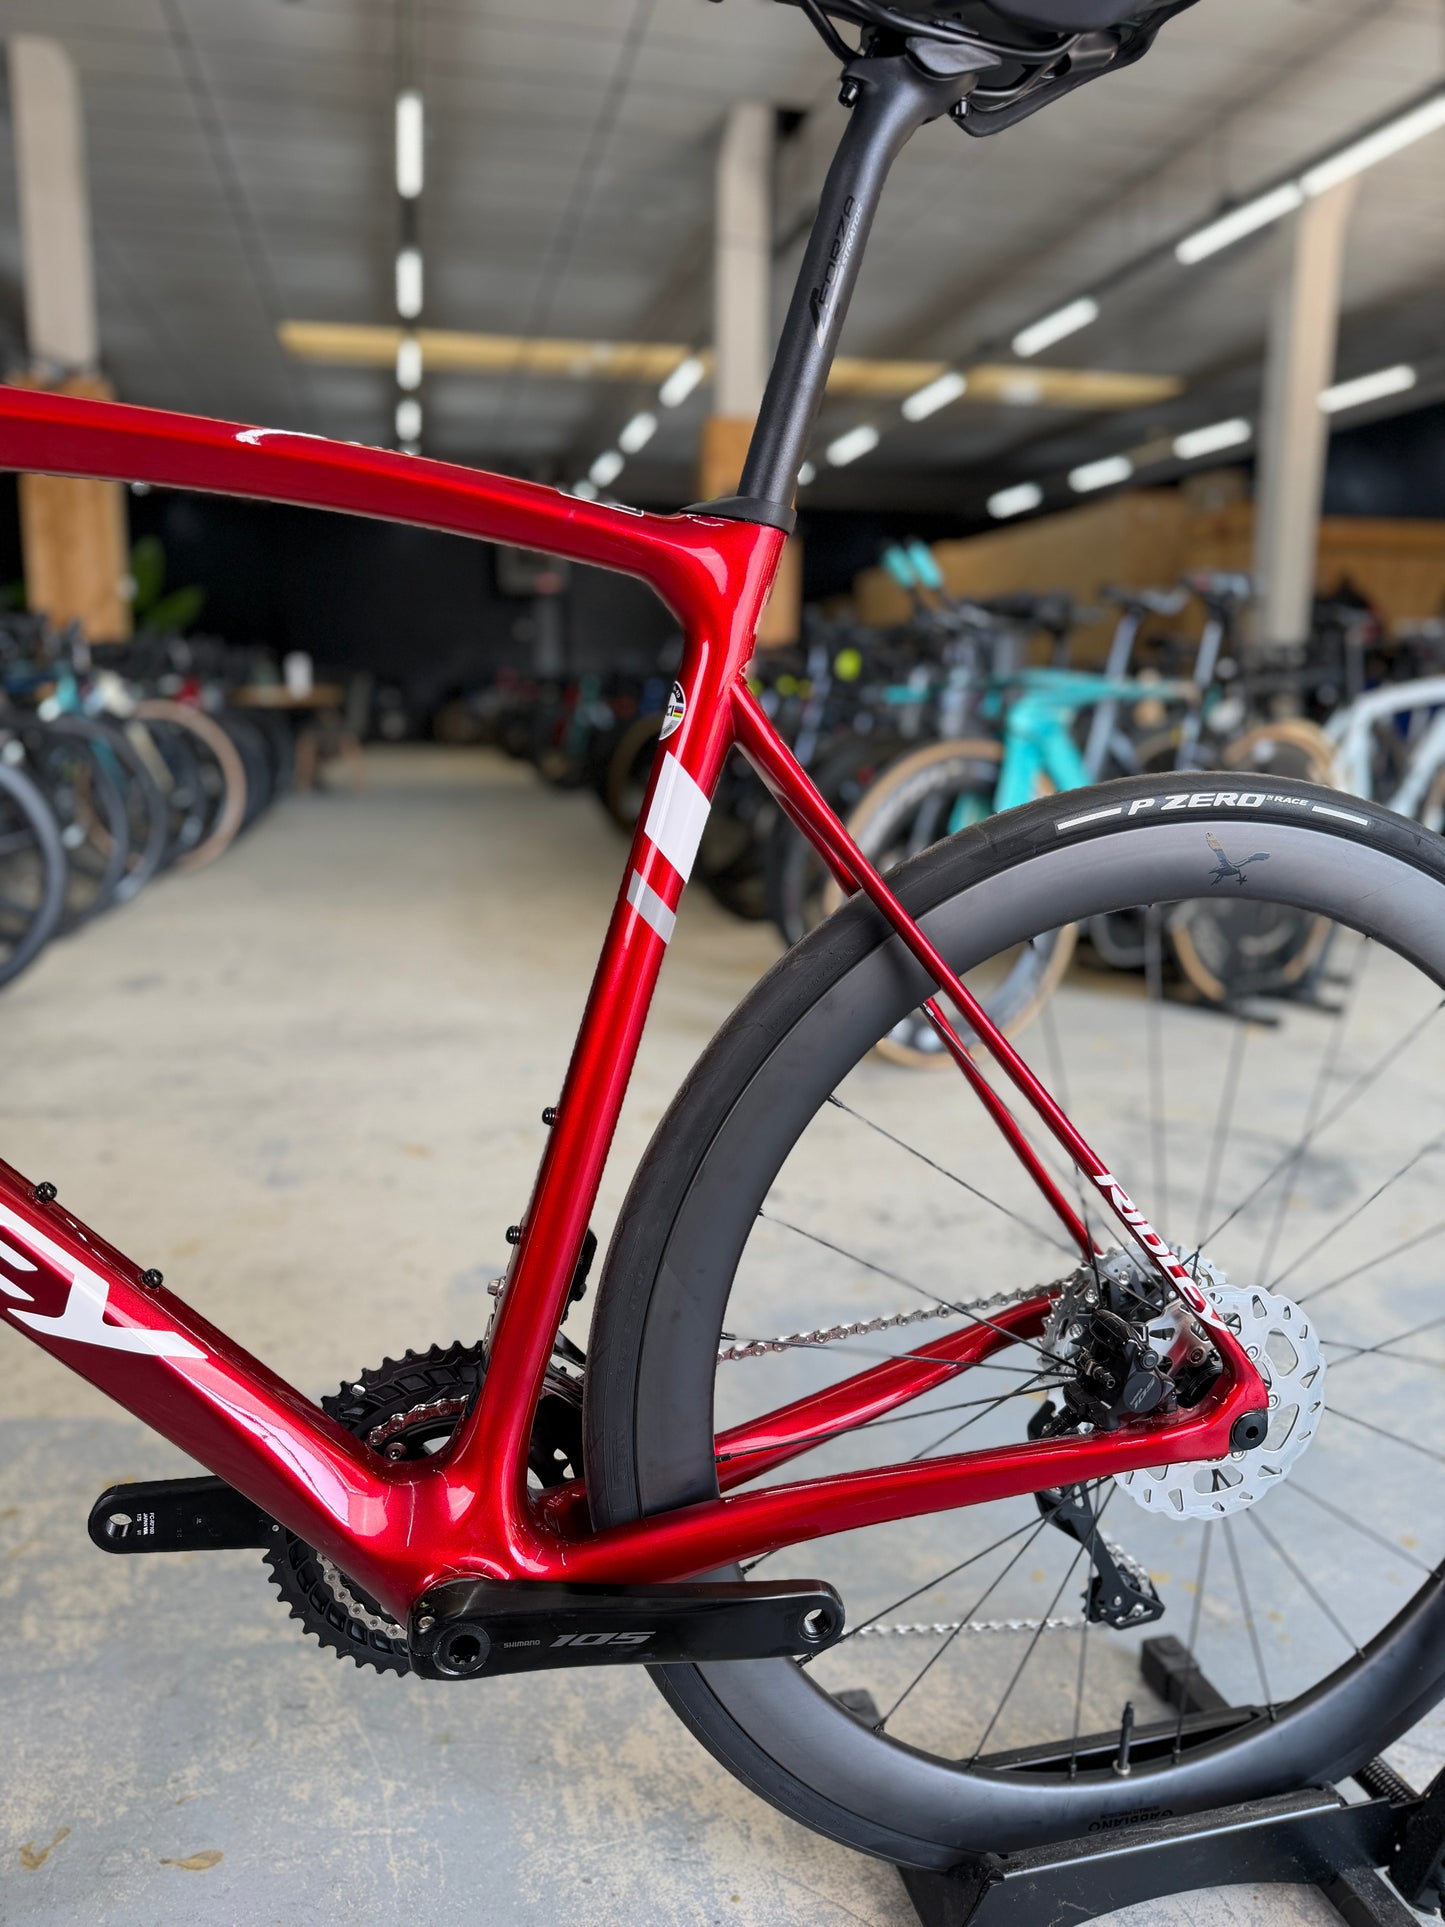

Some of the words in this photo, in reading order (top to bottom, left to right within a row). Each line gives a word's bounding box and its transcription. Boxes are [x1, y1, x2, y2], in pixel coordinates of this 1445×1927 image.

[818, 195, 856, 305] FORZA
[842, 202, 863, 267] STRATOS
[1127, 798, 1156, 816] P
[1160, 792, 1267, 811] ZERO
[1273, 796, 1309, 806] RACE
[1093, 1173, 1230, 1333] RIDLEY
[503, 1639, 541, 1649] SHIMANO
[549, 1631, 657, 1648] 105
